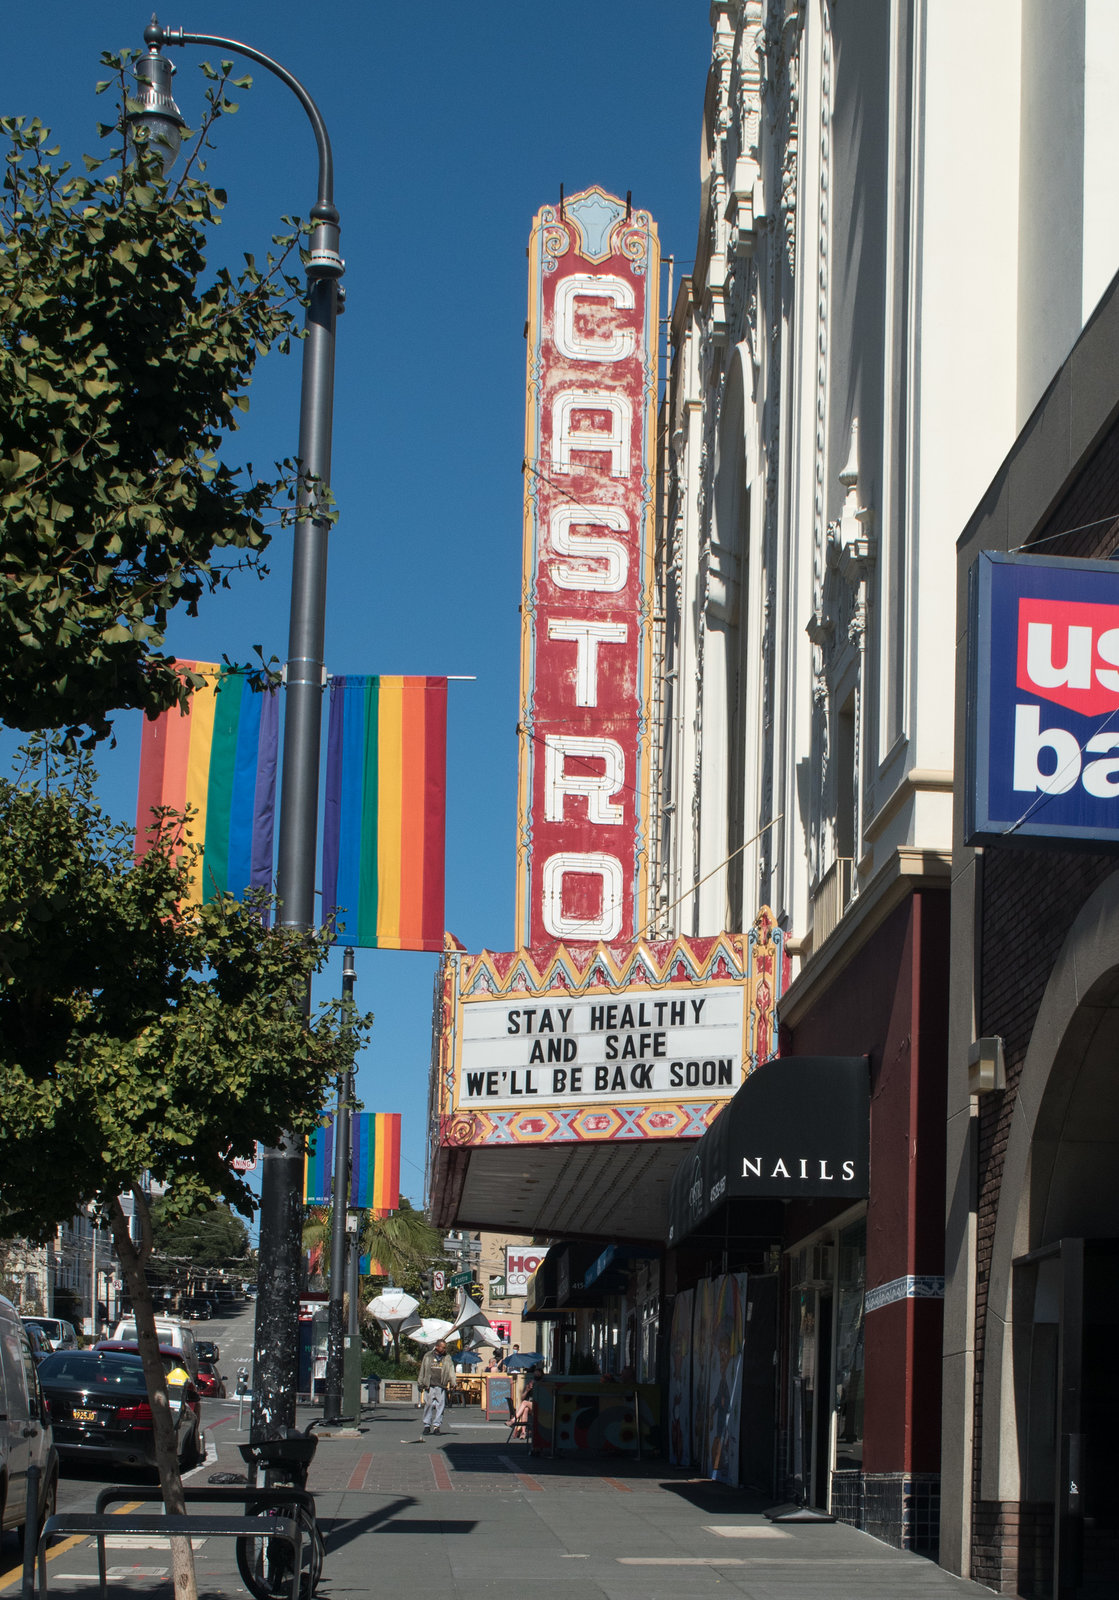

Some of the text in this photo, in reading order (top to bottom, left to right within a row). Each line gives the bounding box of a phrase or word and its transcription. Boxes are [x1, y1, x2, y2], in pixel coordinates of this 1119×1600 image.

[542, 273, 636, 941] CASTRO
[507, 998, 707, 1035] STAY HEALTHY
[529, 1032, 667, 1064] AND SAFE
[466, 1059, 733, 1096] WE'LL BE BACK SOON
[741, 1157, 856, 1181] NAILS
[508, 1255, 545, 1273] HO
[508, 1273, 531, 1285] CO
